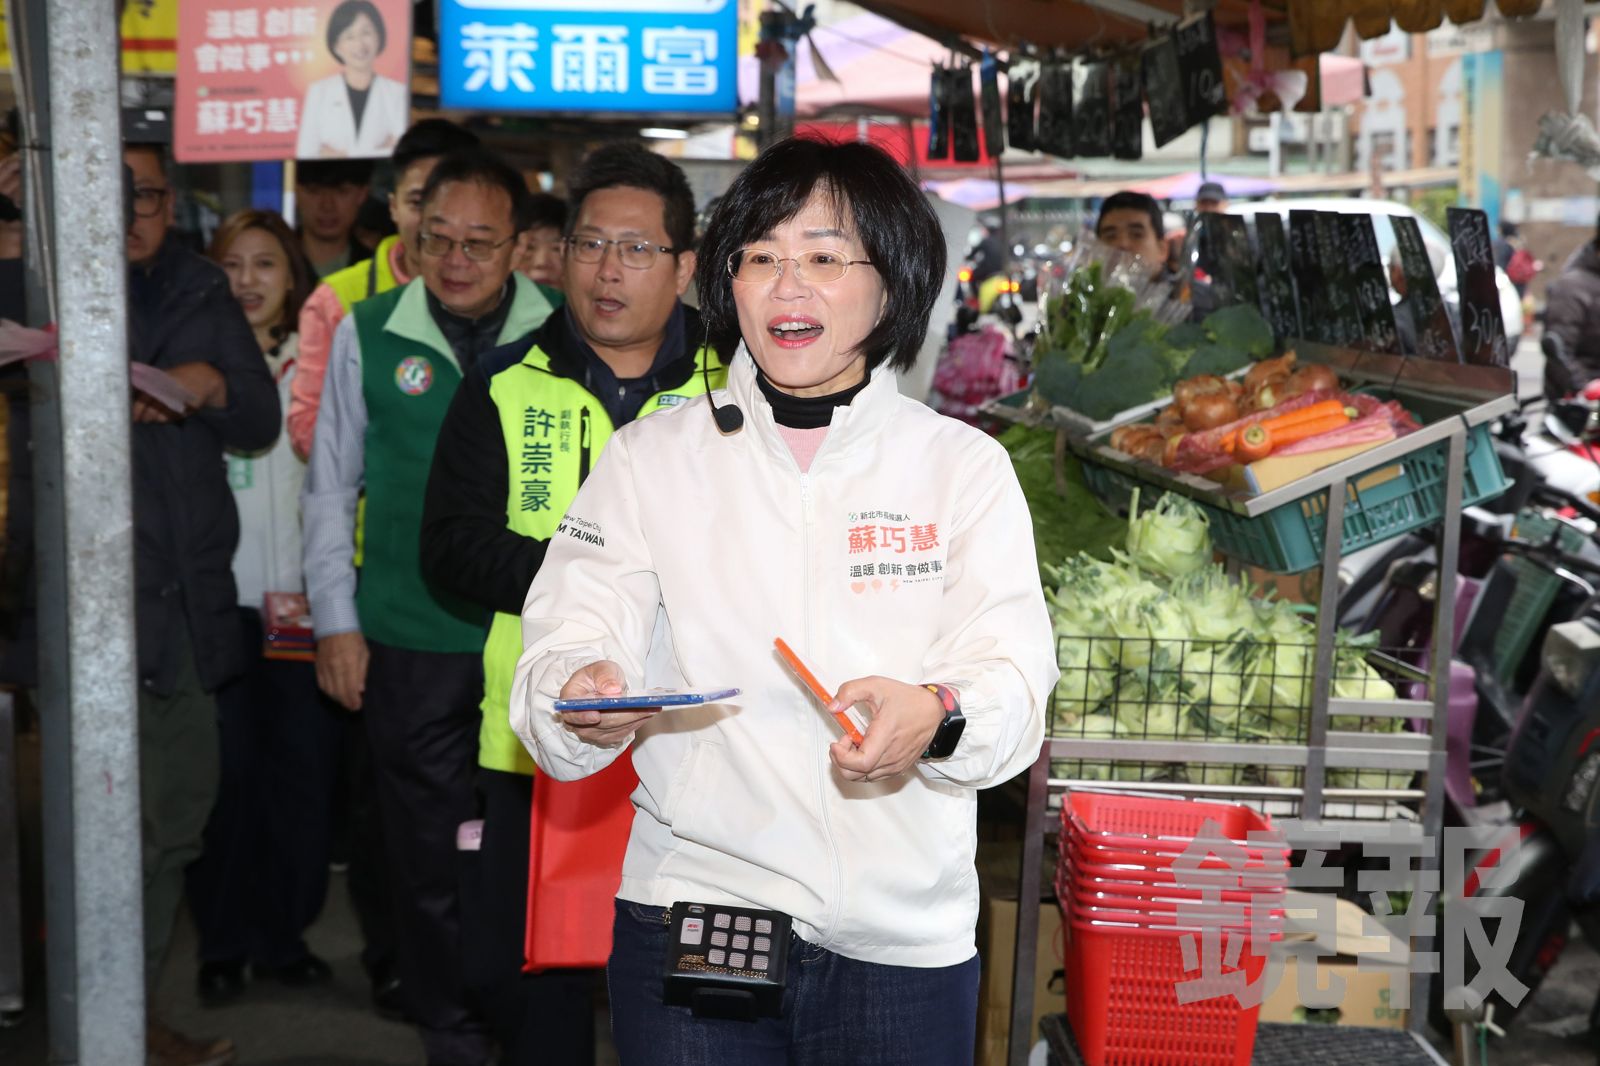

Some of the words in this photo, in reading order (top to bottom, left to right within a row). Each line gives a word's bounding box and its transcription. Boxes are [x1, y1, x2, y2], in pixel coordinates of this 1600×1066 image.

[460, 22, 718, 95] 萊爾富
[197, 97, 296, 134] 蘇巧慧
[520, 405, 556, 512] 許崇豪
[569, 526, 605, 547] TAIWAN
[576, 517, 592, 529] Taipei
[848, 523, 940, 554] 蘇巧慧
[850, 563, 875, 577] 溫暖
[878, 562, 903, 576] 創新
[905, 560, 943, 576] 會做事
